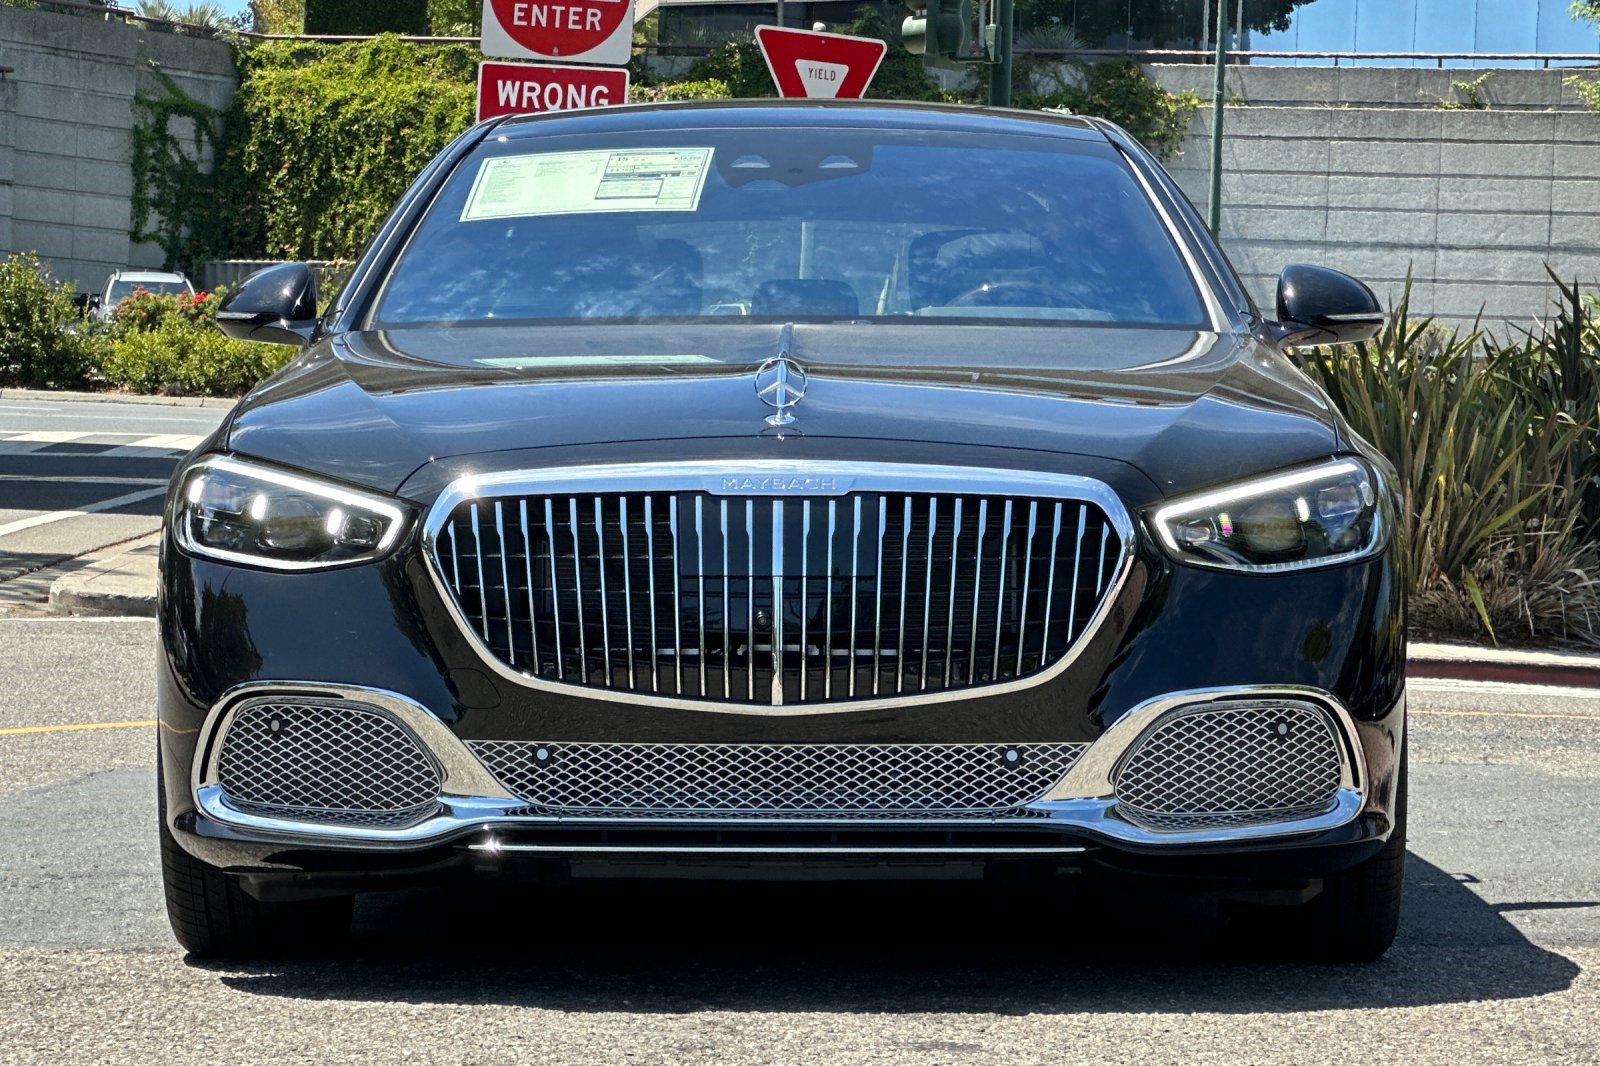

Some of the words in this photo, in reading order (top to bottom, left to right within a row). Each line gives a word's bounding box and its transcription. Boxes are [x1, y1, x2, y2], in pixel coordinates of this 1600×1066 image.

[513, 3, 602, 31] ENTER
[808, 67, 836, 81] YIELD
[497, 79, 609, 111] WRONG
[722, 478, 836, 490] MAYBACH
